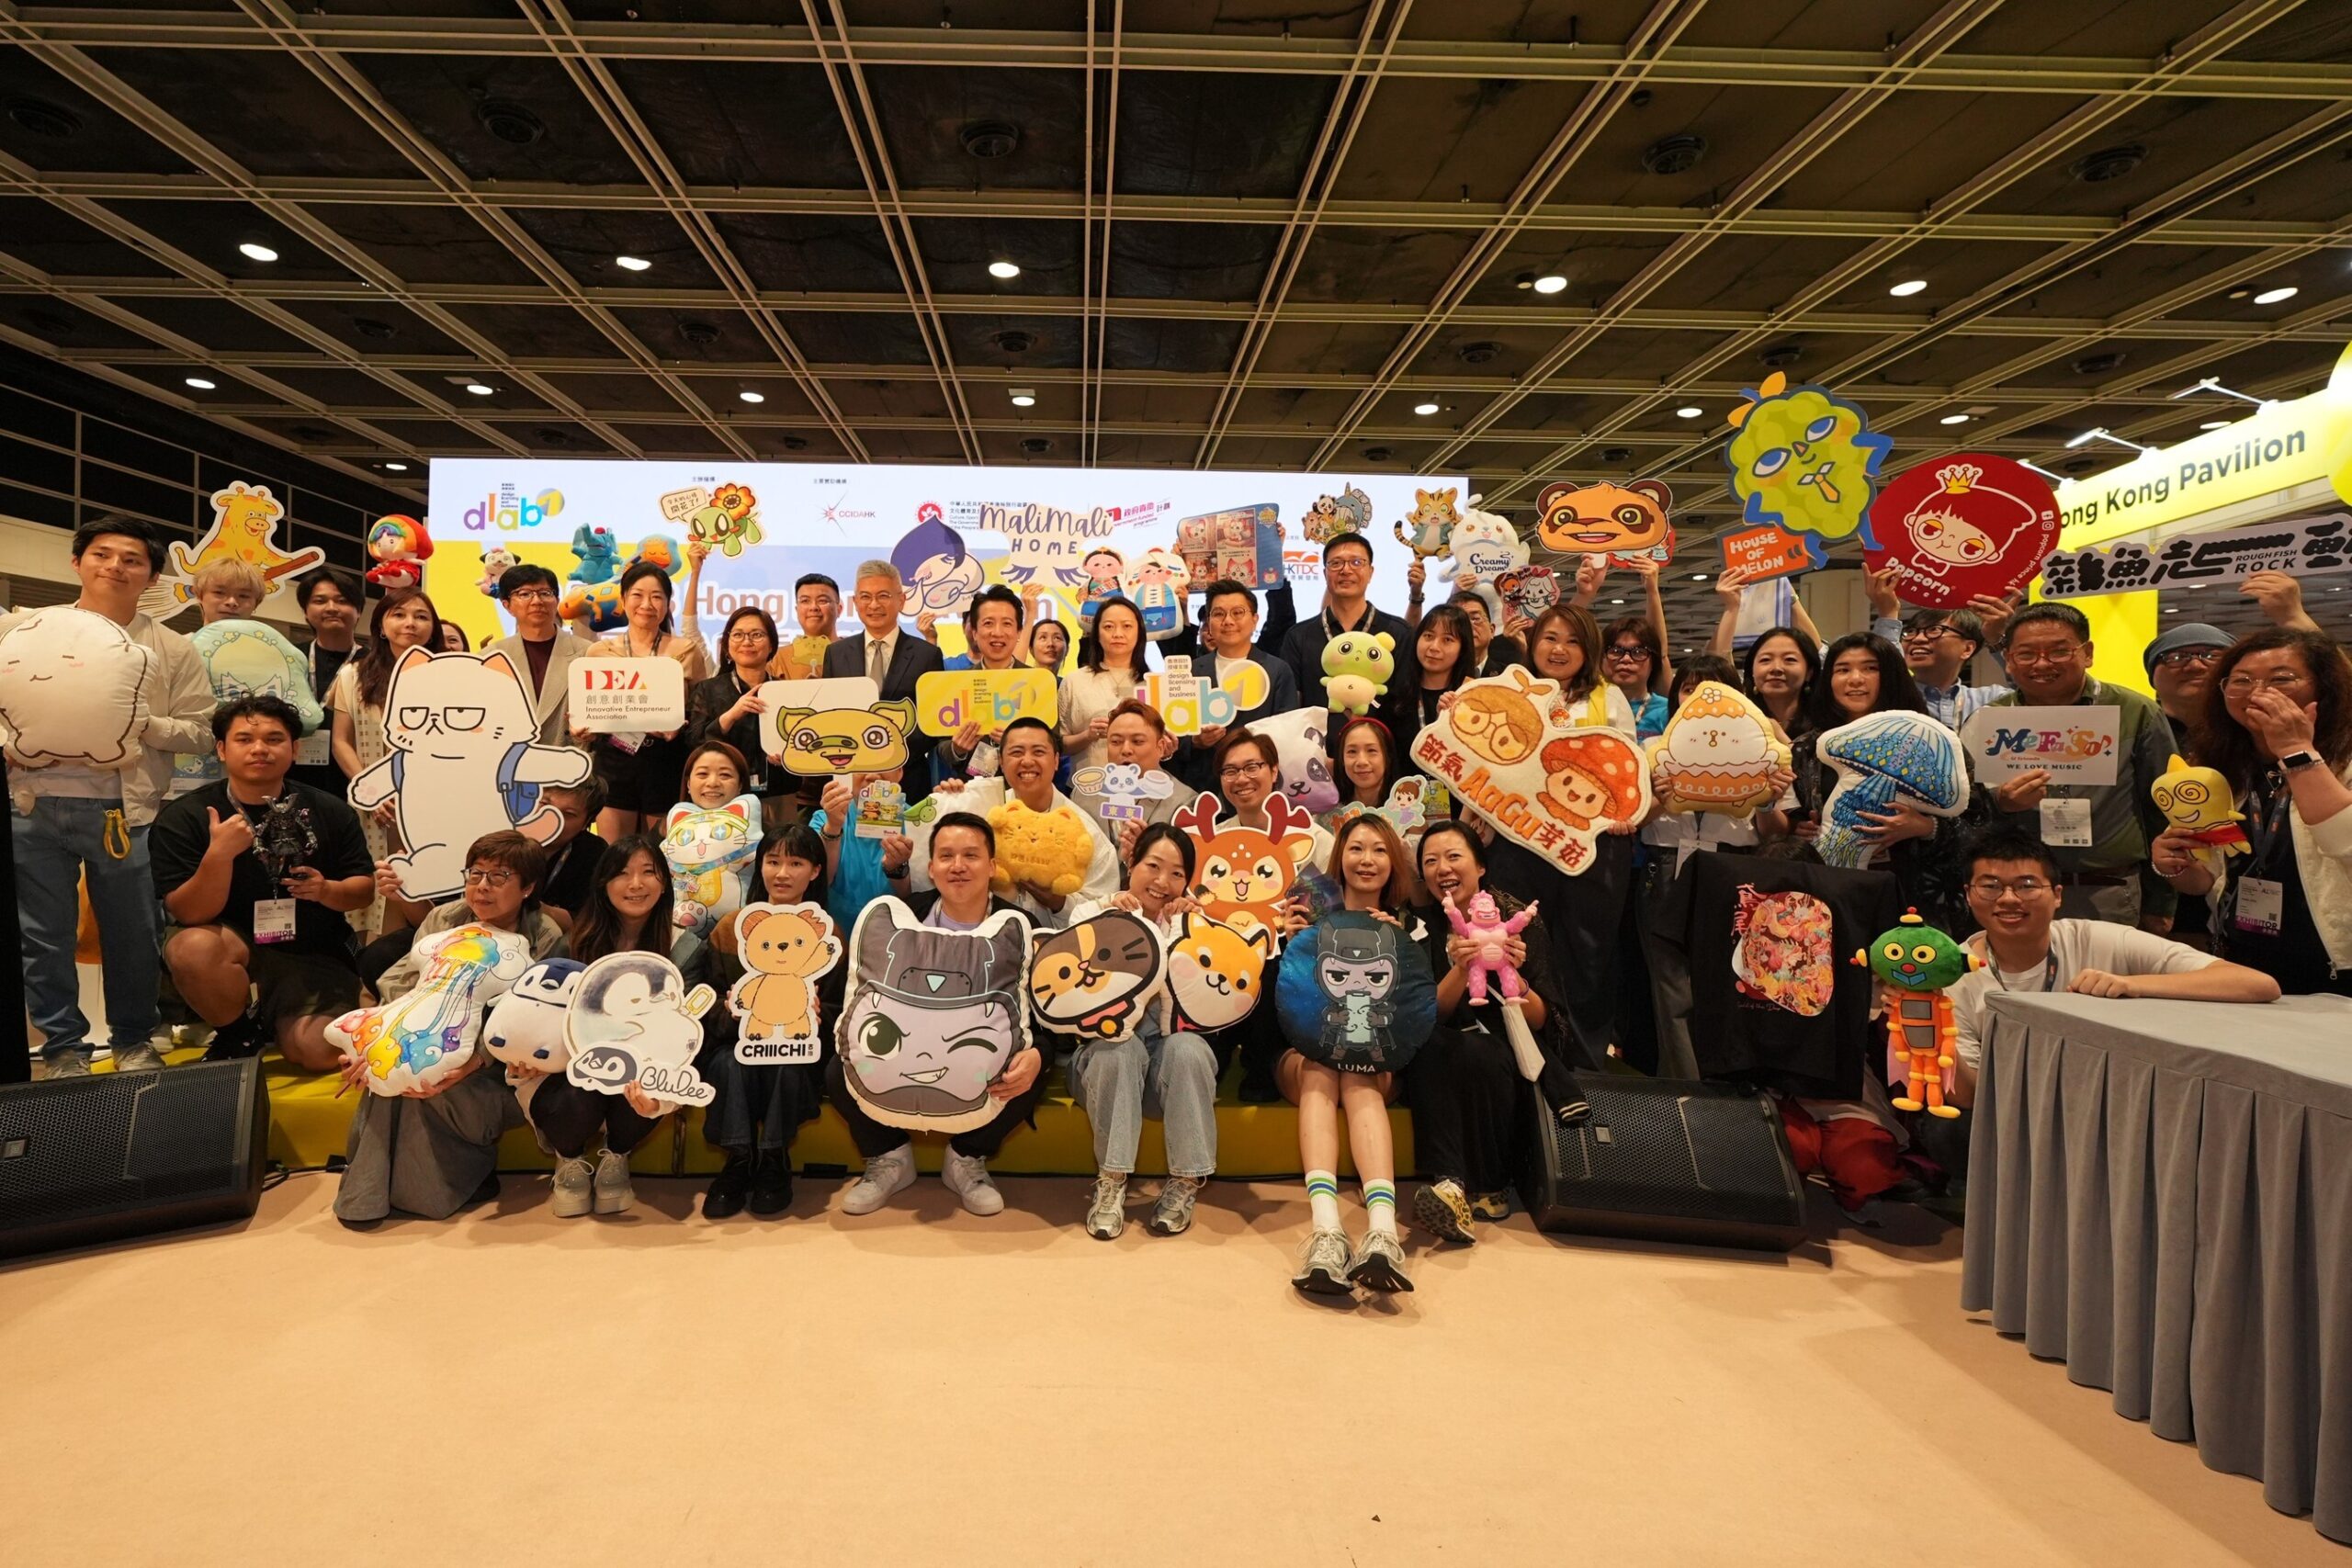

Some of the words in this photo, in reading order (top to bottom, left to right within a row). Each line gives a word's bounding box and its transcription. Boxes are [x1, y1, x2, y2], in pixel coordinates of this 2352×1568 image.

[2061, 500, 2098, 529] ong
[2106, 476, 2170, 515] Kong
[2180, 429, 2306, 491] Pavilion
[1012, 537, 1079, 556] HOME
[1729, 532, 1779, 554] HOUSE
[1470, 552, 1511, 569] Creamy
[1747, 547, 1765, 560] OF
[2235, 551, 2270, 562] ROUGH
[2272, 548, 2298, 559] FISH
[1475, 565, 1506, 574] Dream
[2233, 557, 2297, 574] ROCK
[1900, 579, 1942, 604] ince
[584, 670, 648, 690] IDEA
[625, 705, 671, 714] Entrepreneur
[1418, 733, 1467, 783] 節氣
[741, 1043, 807, 1058] CRIIICHI
[1338, 1063, 1376, 1073] LUMA
